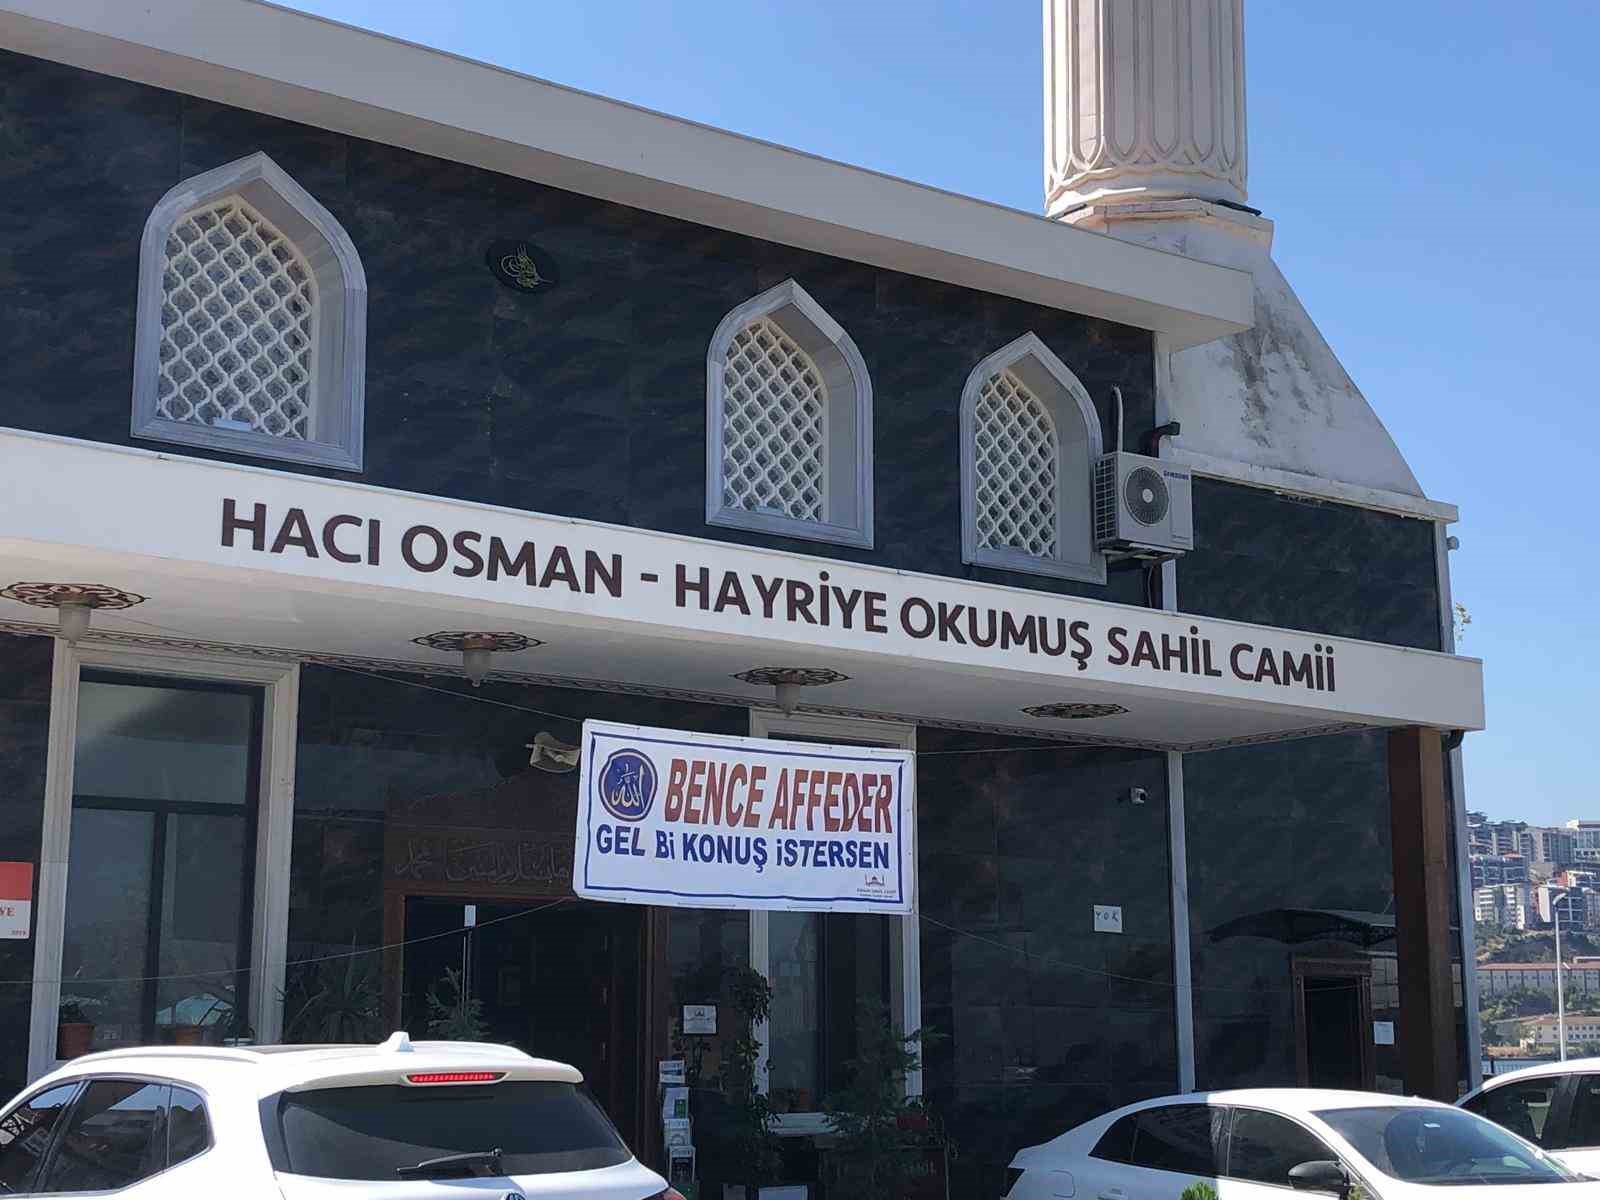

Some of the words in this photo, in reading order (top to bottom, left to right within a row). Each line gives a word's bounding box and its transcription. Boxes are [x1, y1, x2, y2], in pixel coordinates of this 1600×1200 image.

[220, 498, 381, 567] HACI
[400, 524, 623, 598] OSMAN
[675, 563, 889, 634] HAYRİYE
[899, 596, 1093, 671] OKUMUŞ
[1107, 624, 1223, 678] SAHİL
[663, 758, 767, 828] BENCE
[767, 767, 893, 834] AFFEDER
[596, 823, 646, 857] GEL
[682, 832, 768, 873] KONUŞ
